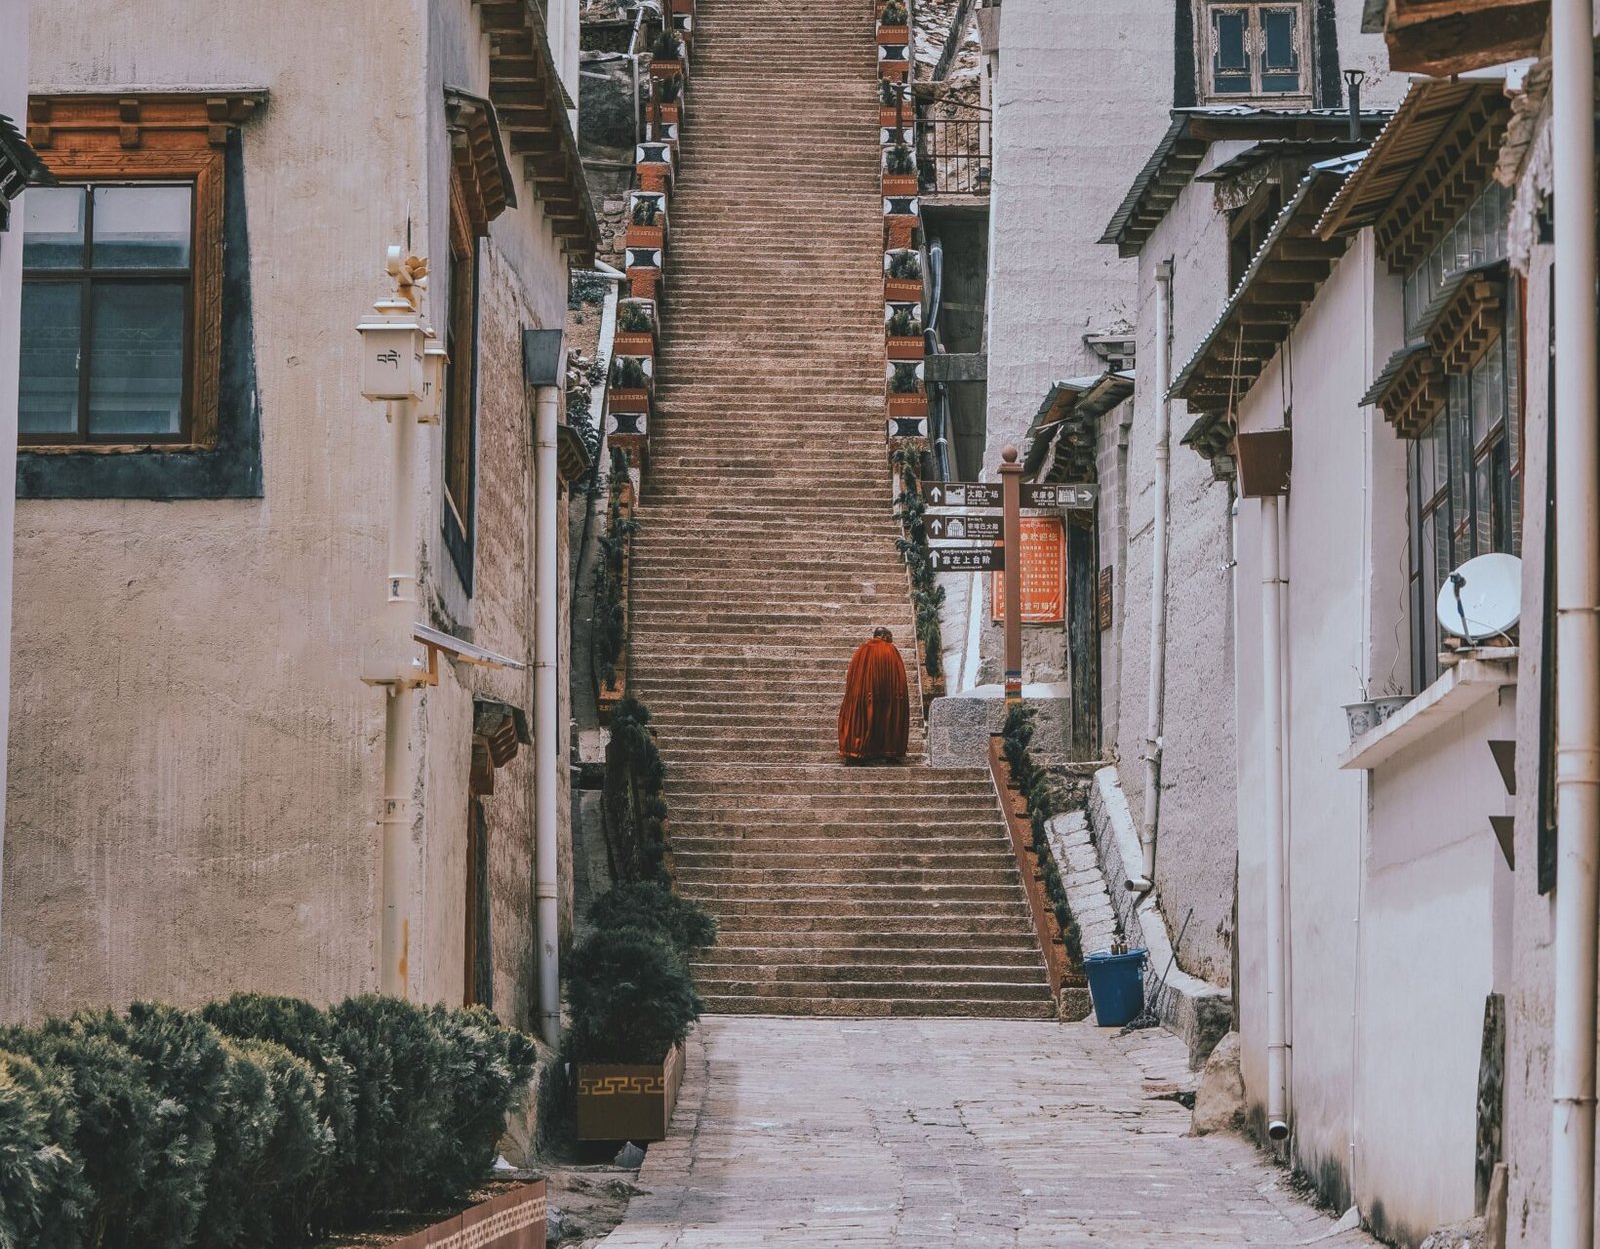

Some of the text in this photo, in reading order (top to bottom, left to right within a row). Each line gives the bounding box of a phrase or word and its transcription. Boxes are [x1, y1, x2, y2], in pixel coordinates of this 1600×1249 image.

[967, 489, 999, 499] 大殿广场
[942, 555, 991, 565] 靠左上台阶
